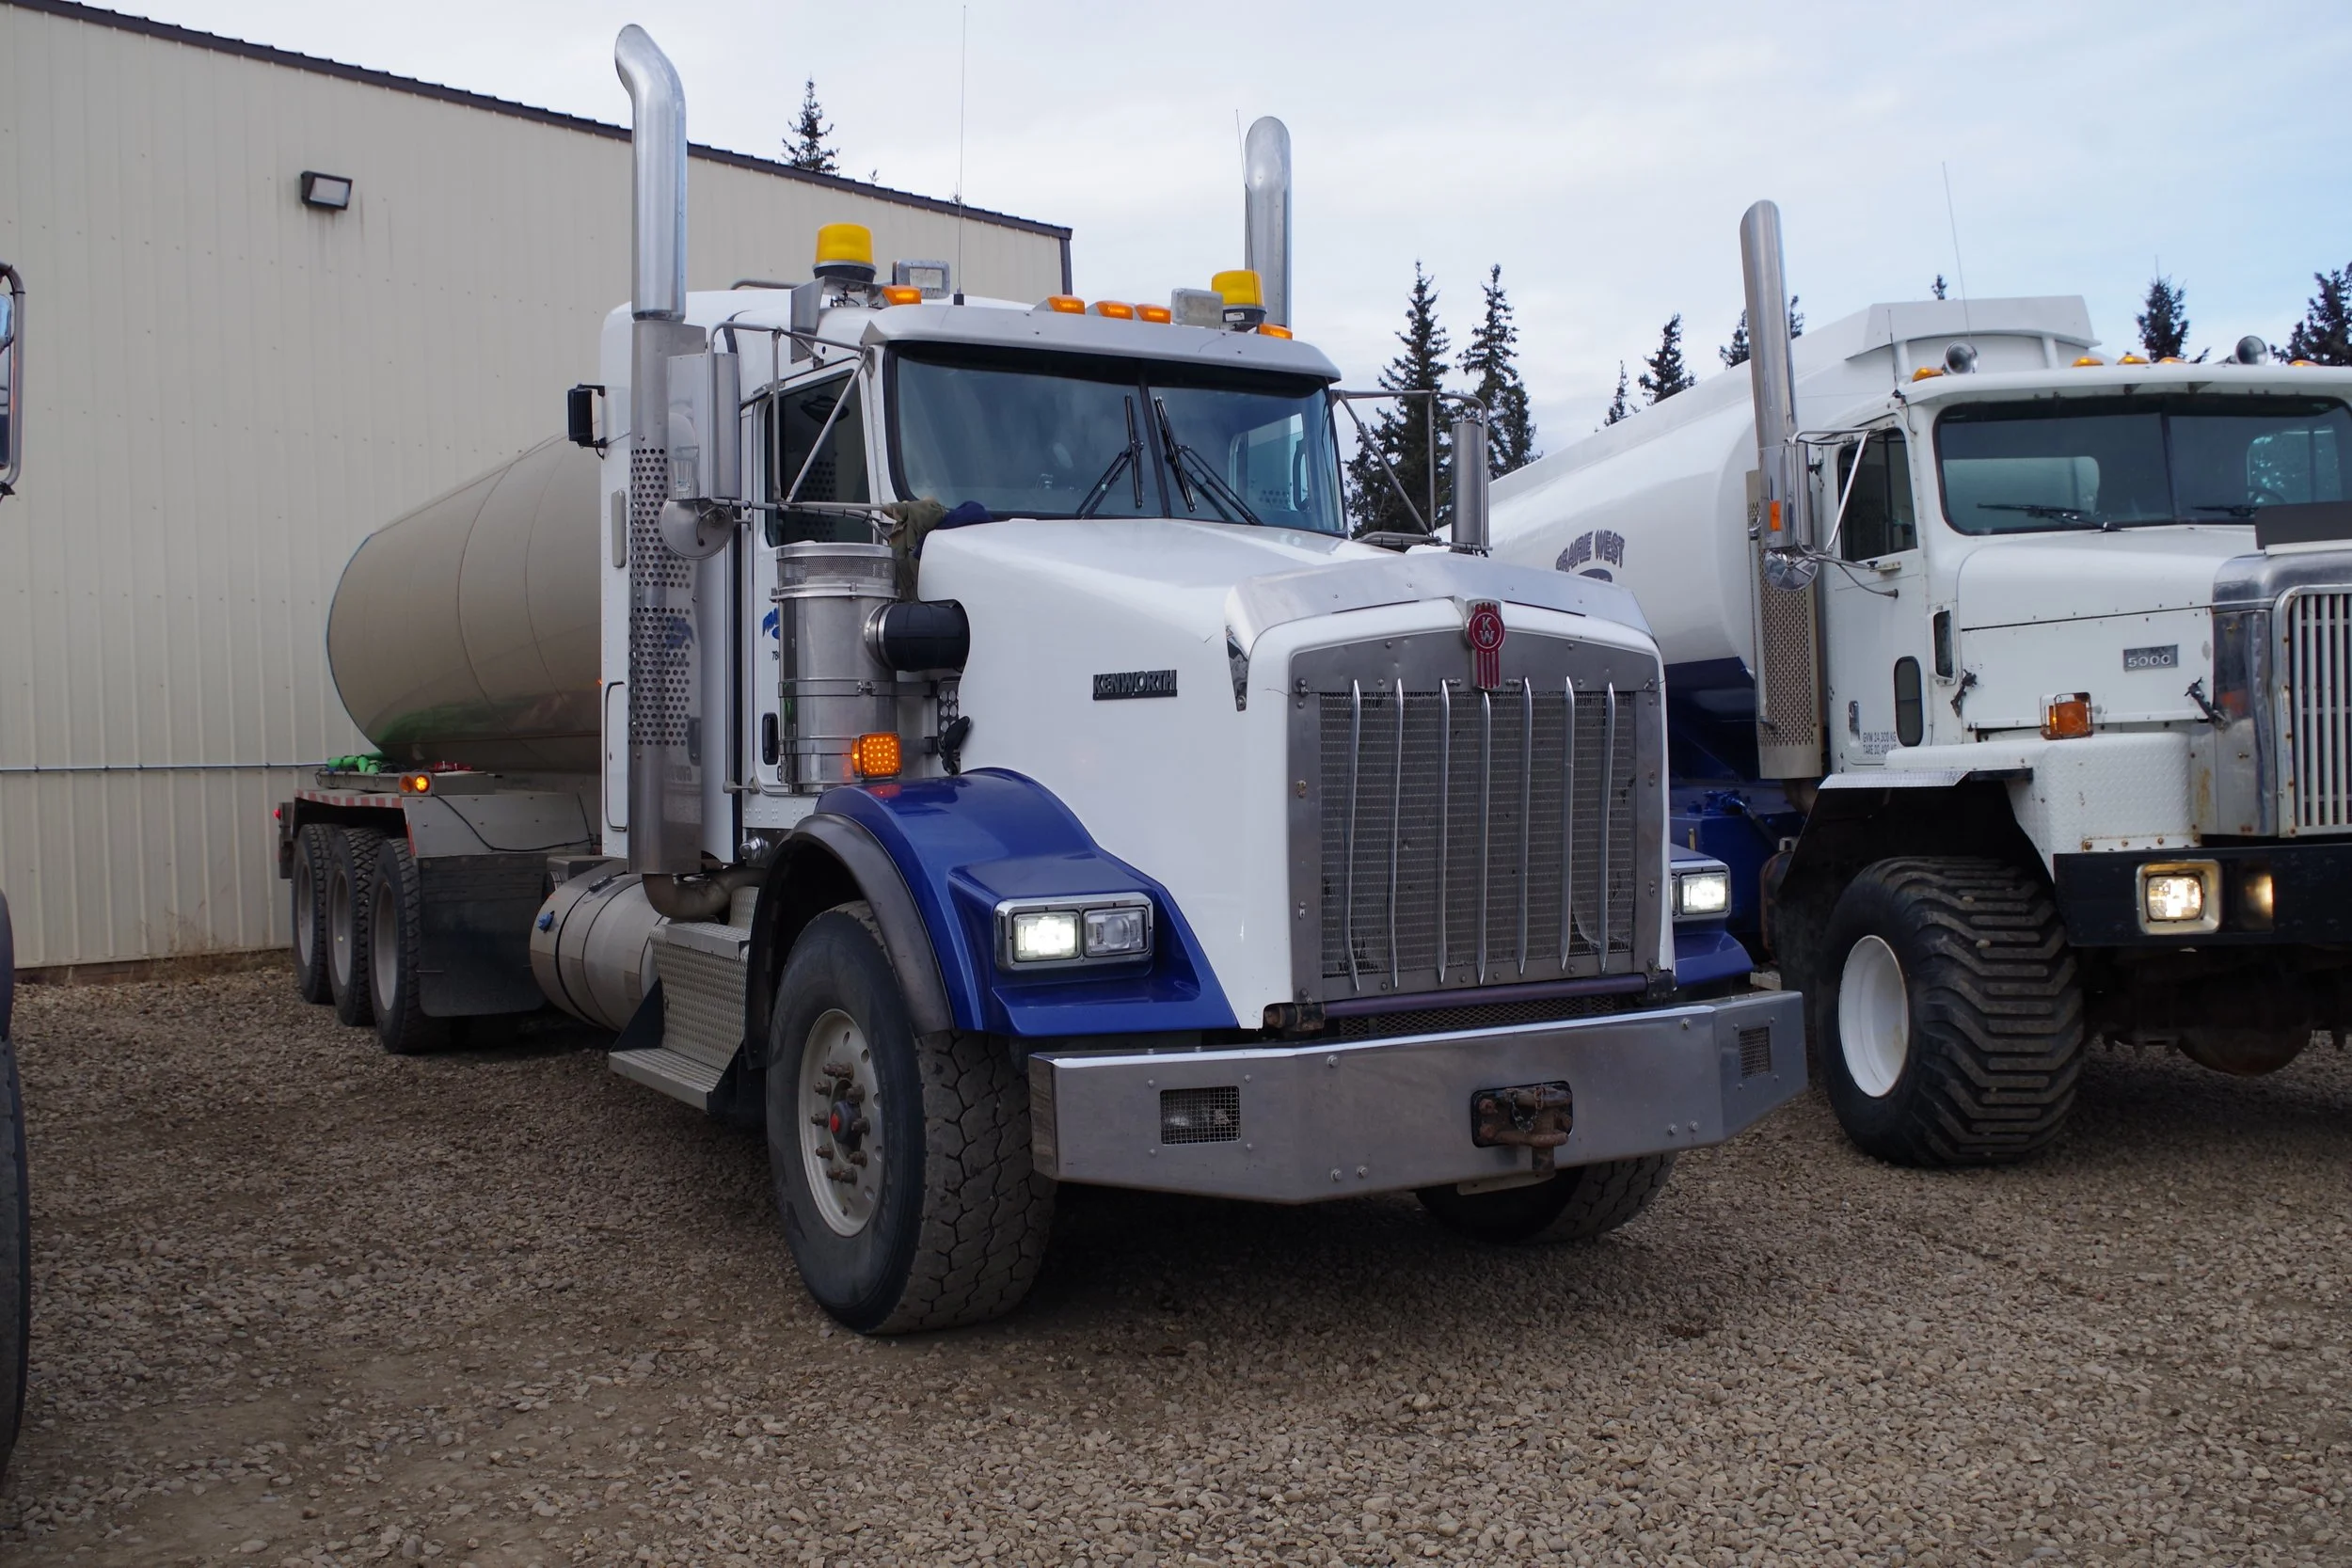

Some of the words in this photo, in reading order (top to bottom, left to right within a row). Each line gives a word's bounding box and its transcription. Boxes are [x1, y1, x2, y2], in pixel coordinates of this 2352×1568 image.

[1555, 531, 1594, 573] PRAIRIE
[1595, 529, 1626, 569] WEST
[1482, 616, 1492, 630] K
[1479, 630, 1495, 644] W
[2127, 655, 2170, 667] 5000
[1092, 669, 1178, 694] KENWORTH
[1863, 732, 1873, 743] GVW
